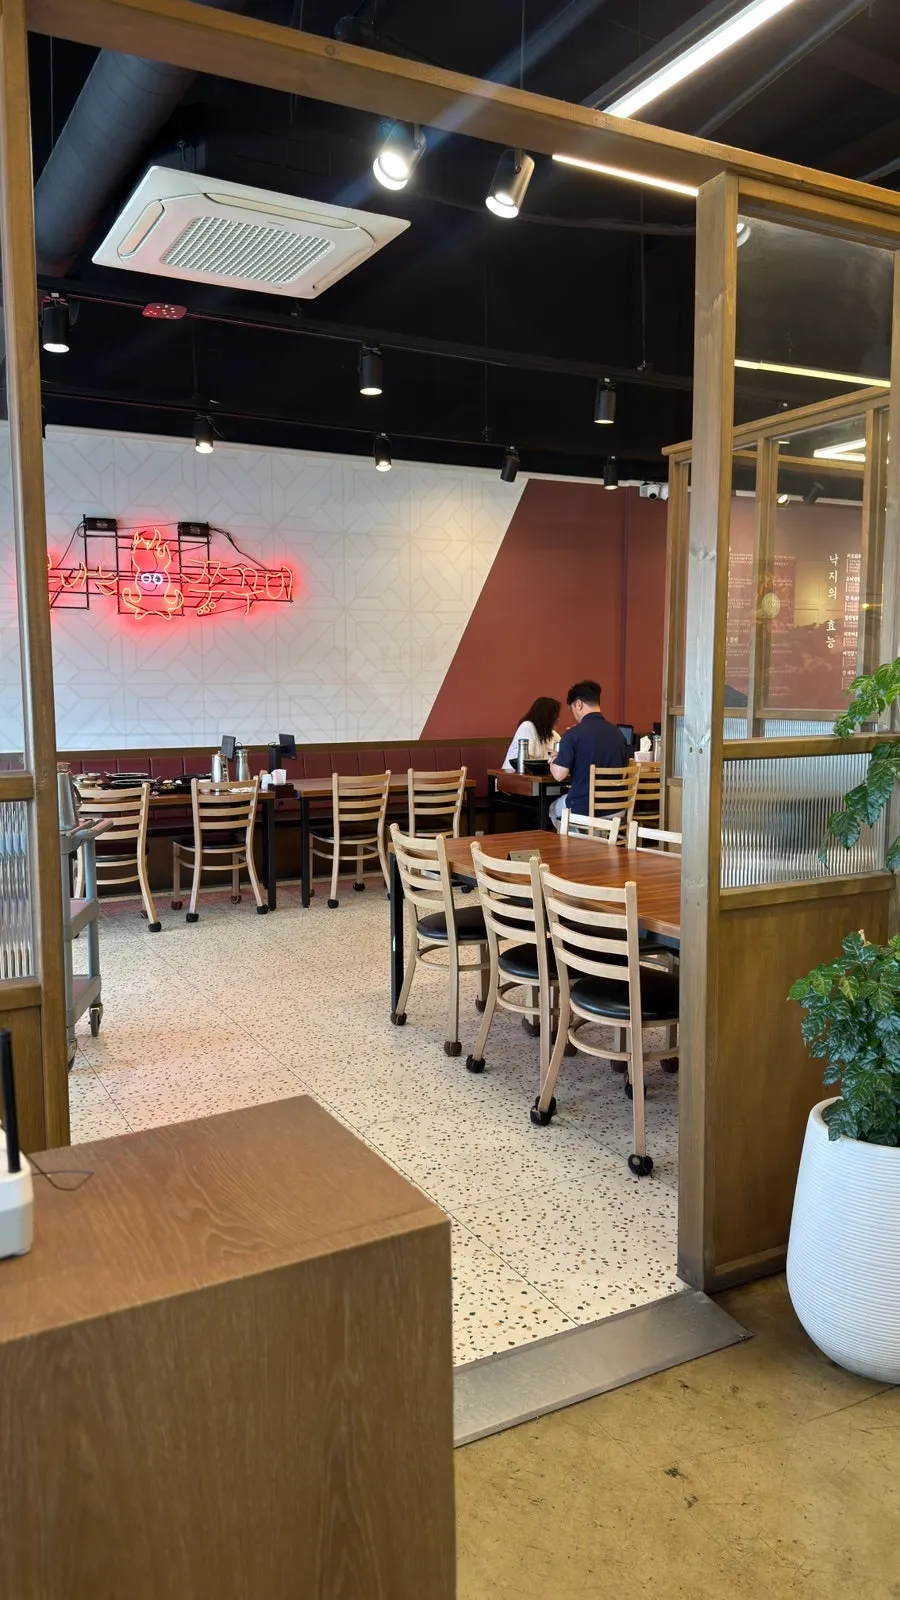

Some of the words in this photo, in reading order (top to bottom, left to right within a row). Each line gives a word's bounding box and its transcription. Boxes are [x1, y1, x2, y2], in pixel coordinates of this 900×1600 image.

[180, 558, 293, 616] 쭈꾸미
[828, 553, 839, 600] 낙지의
[826, 619, 836, 649] 효능
